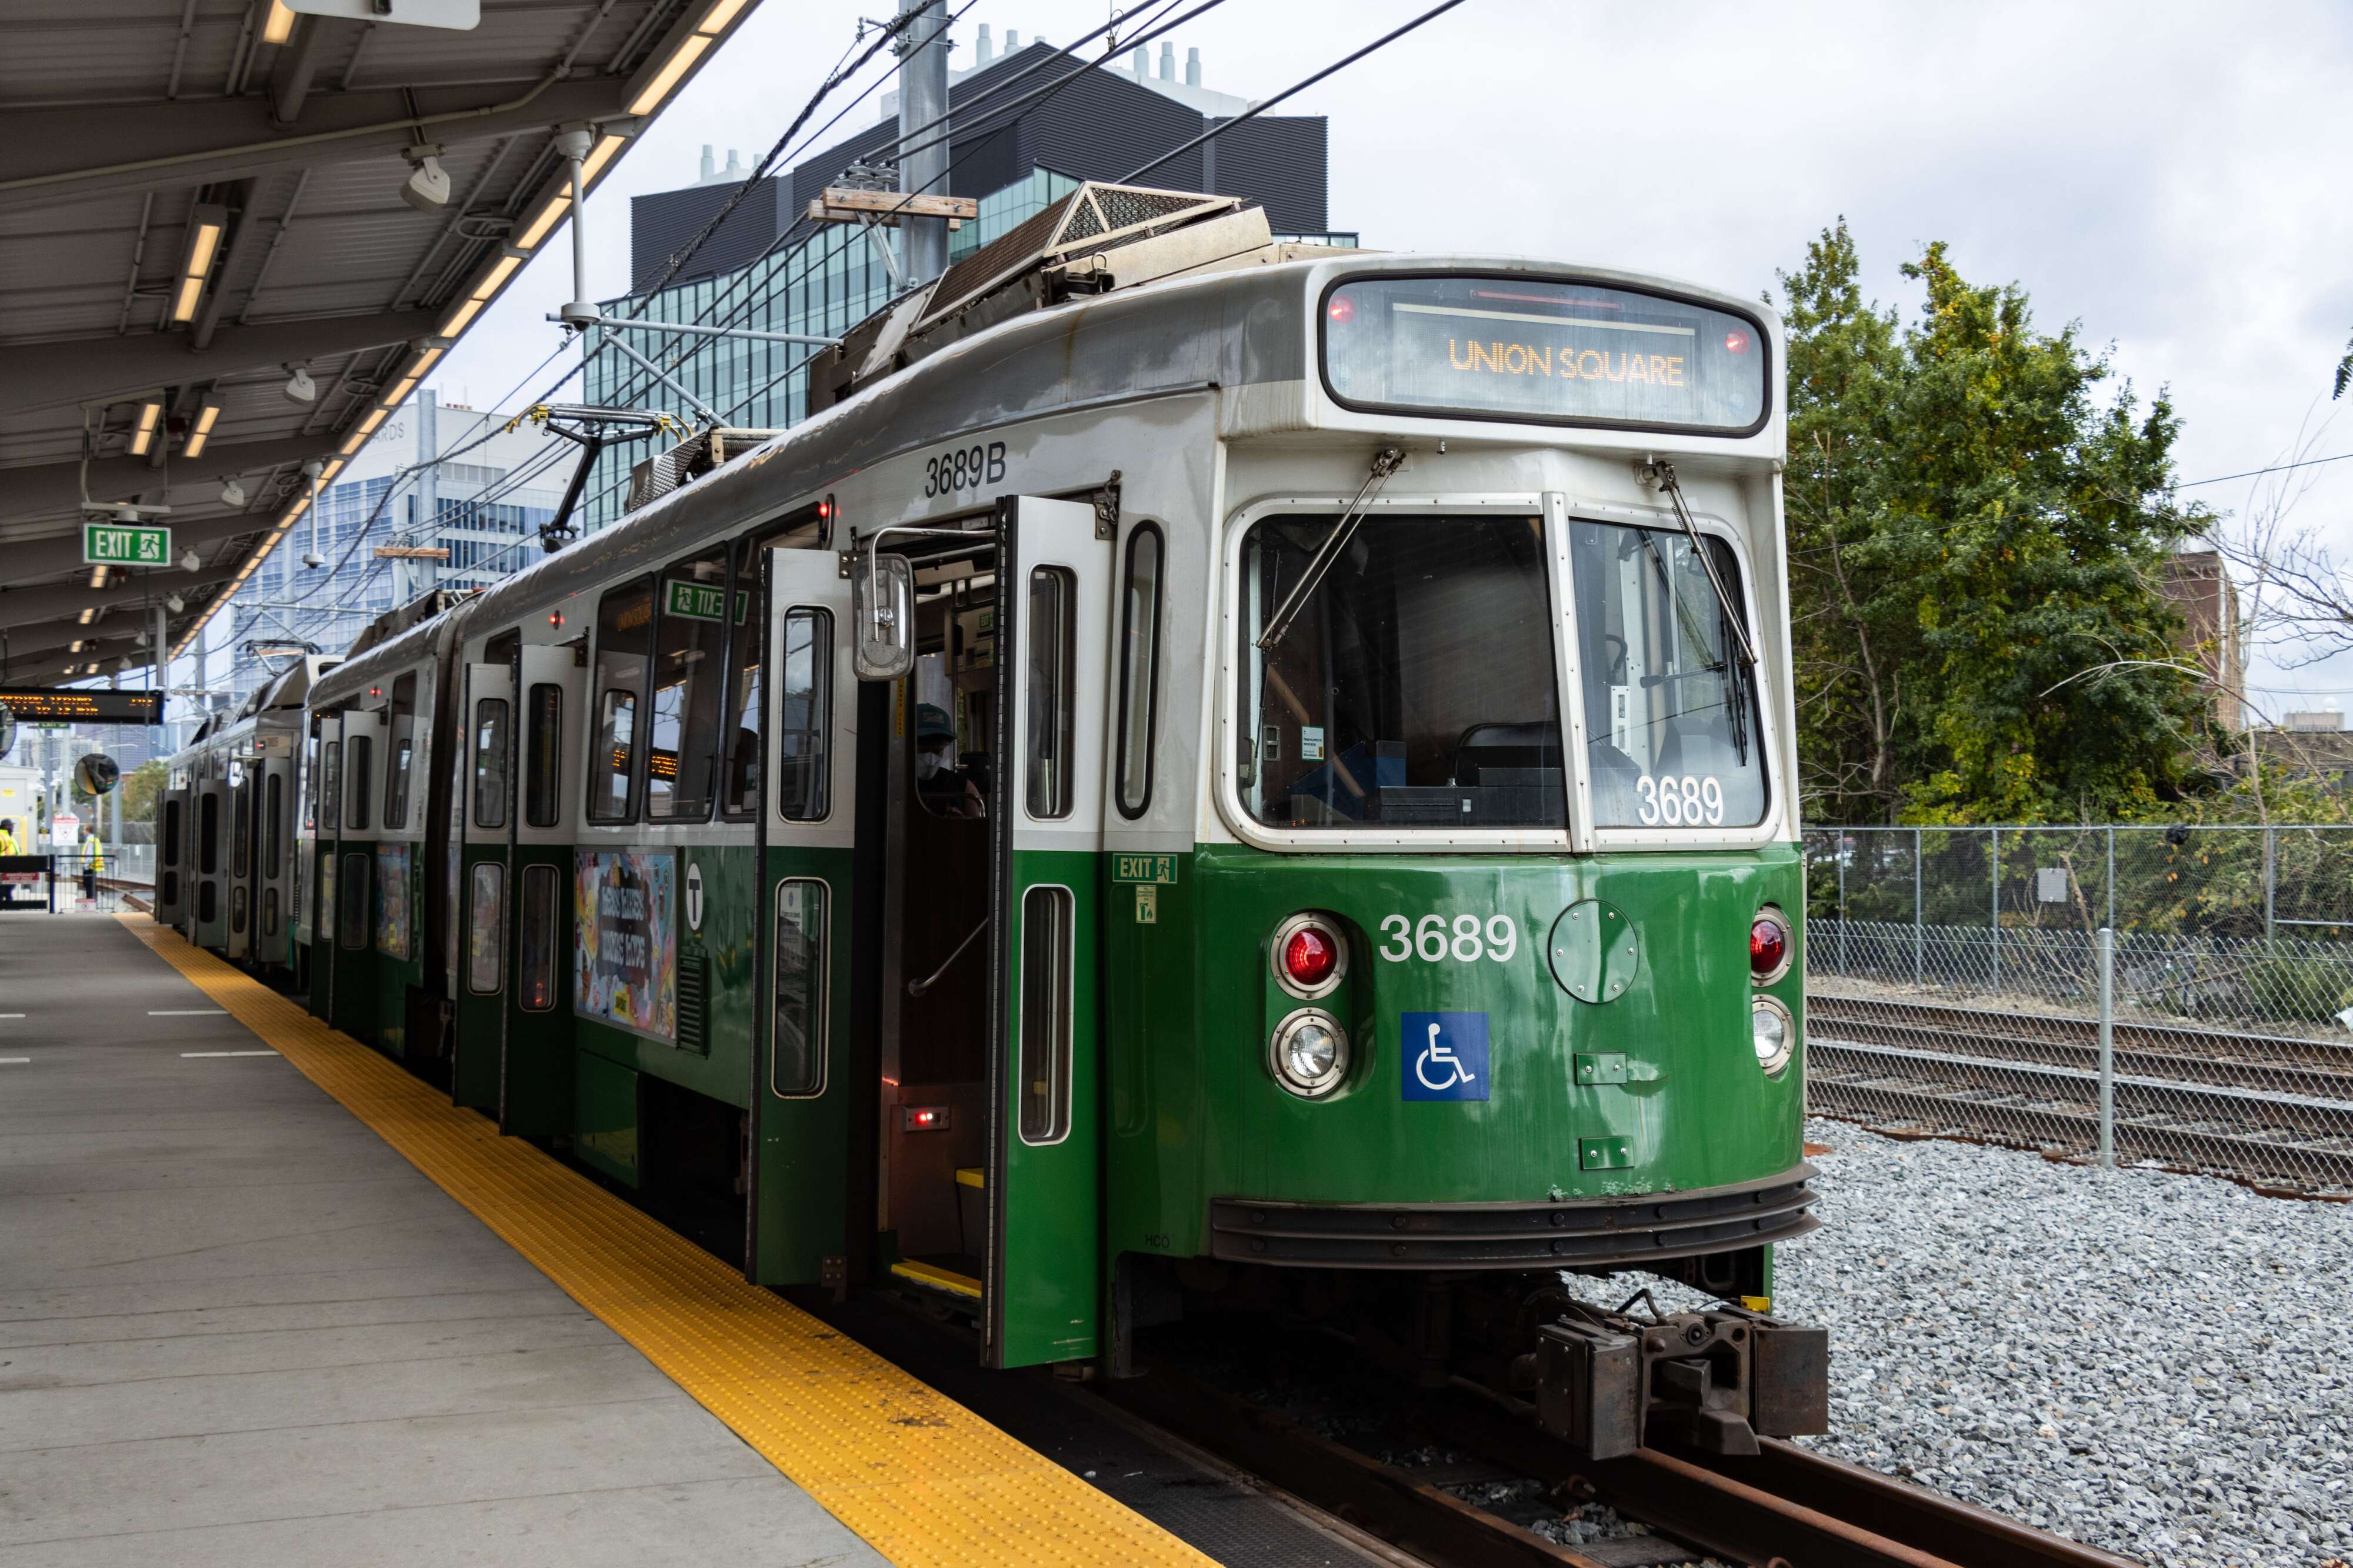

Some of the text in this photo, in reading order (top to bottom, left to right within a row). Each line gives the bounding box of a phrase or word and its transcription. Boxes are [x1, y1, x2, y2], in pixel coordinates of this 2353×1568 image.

[1449, 338, 1684, 387] UNION SQUARE
[925, 441, 1006, 499] 3689B
[95, 530, 133, 559] EXIT
[1636, 775, 1724, 826] 3689
[1119, 857, 1152, 878] EXIT
[688, 879, 701, 922] T
[1379, 913, 1517, 963] 3689
